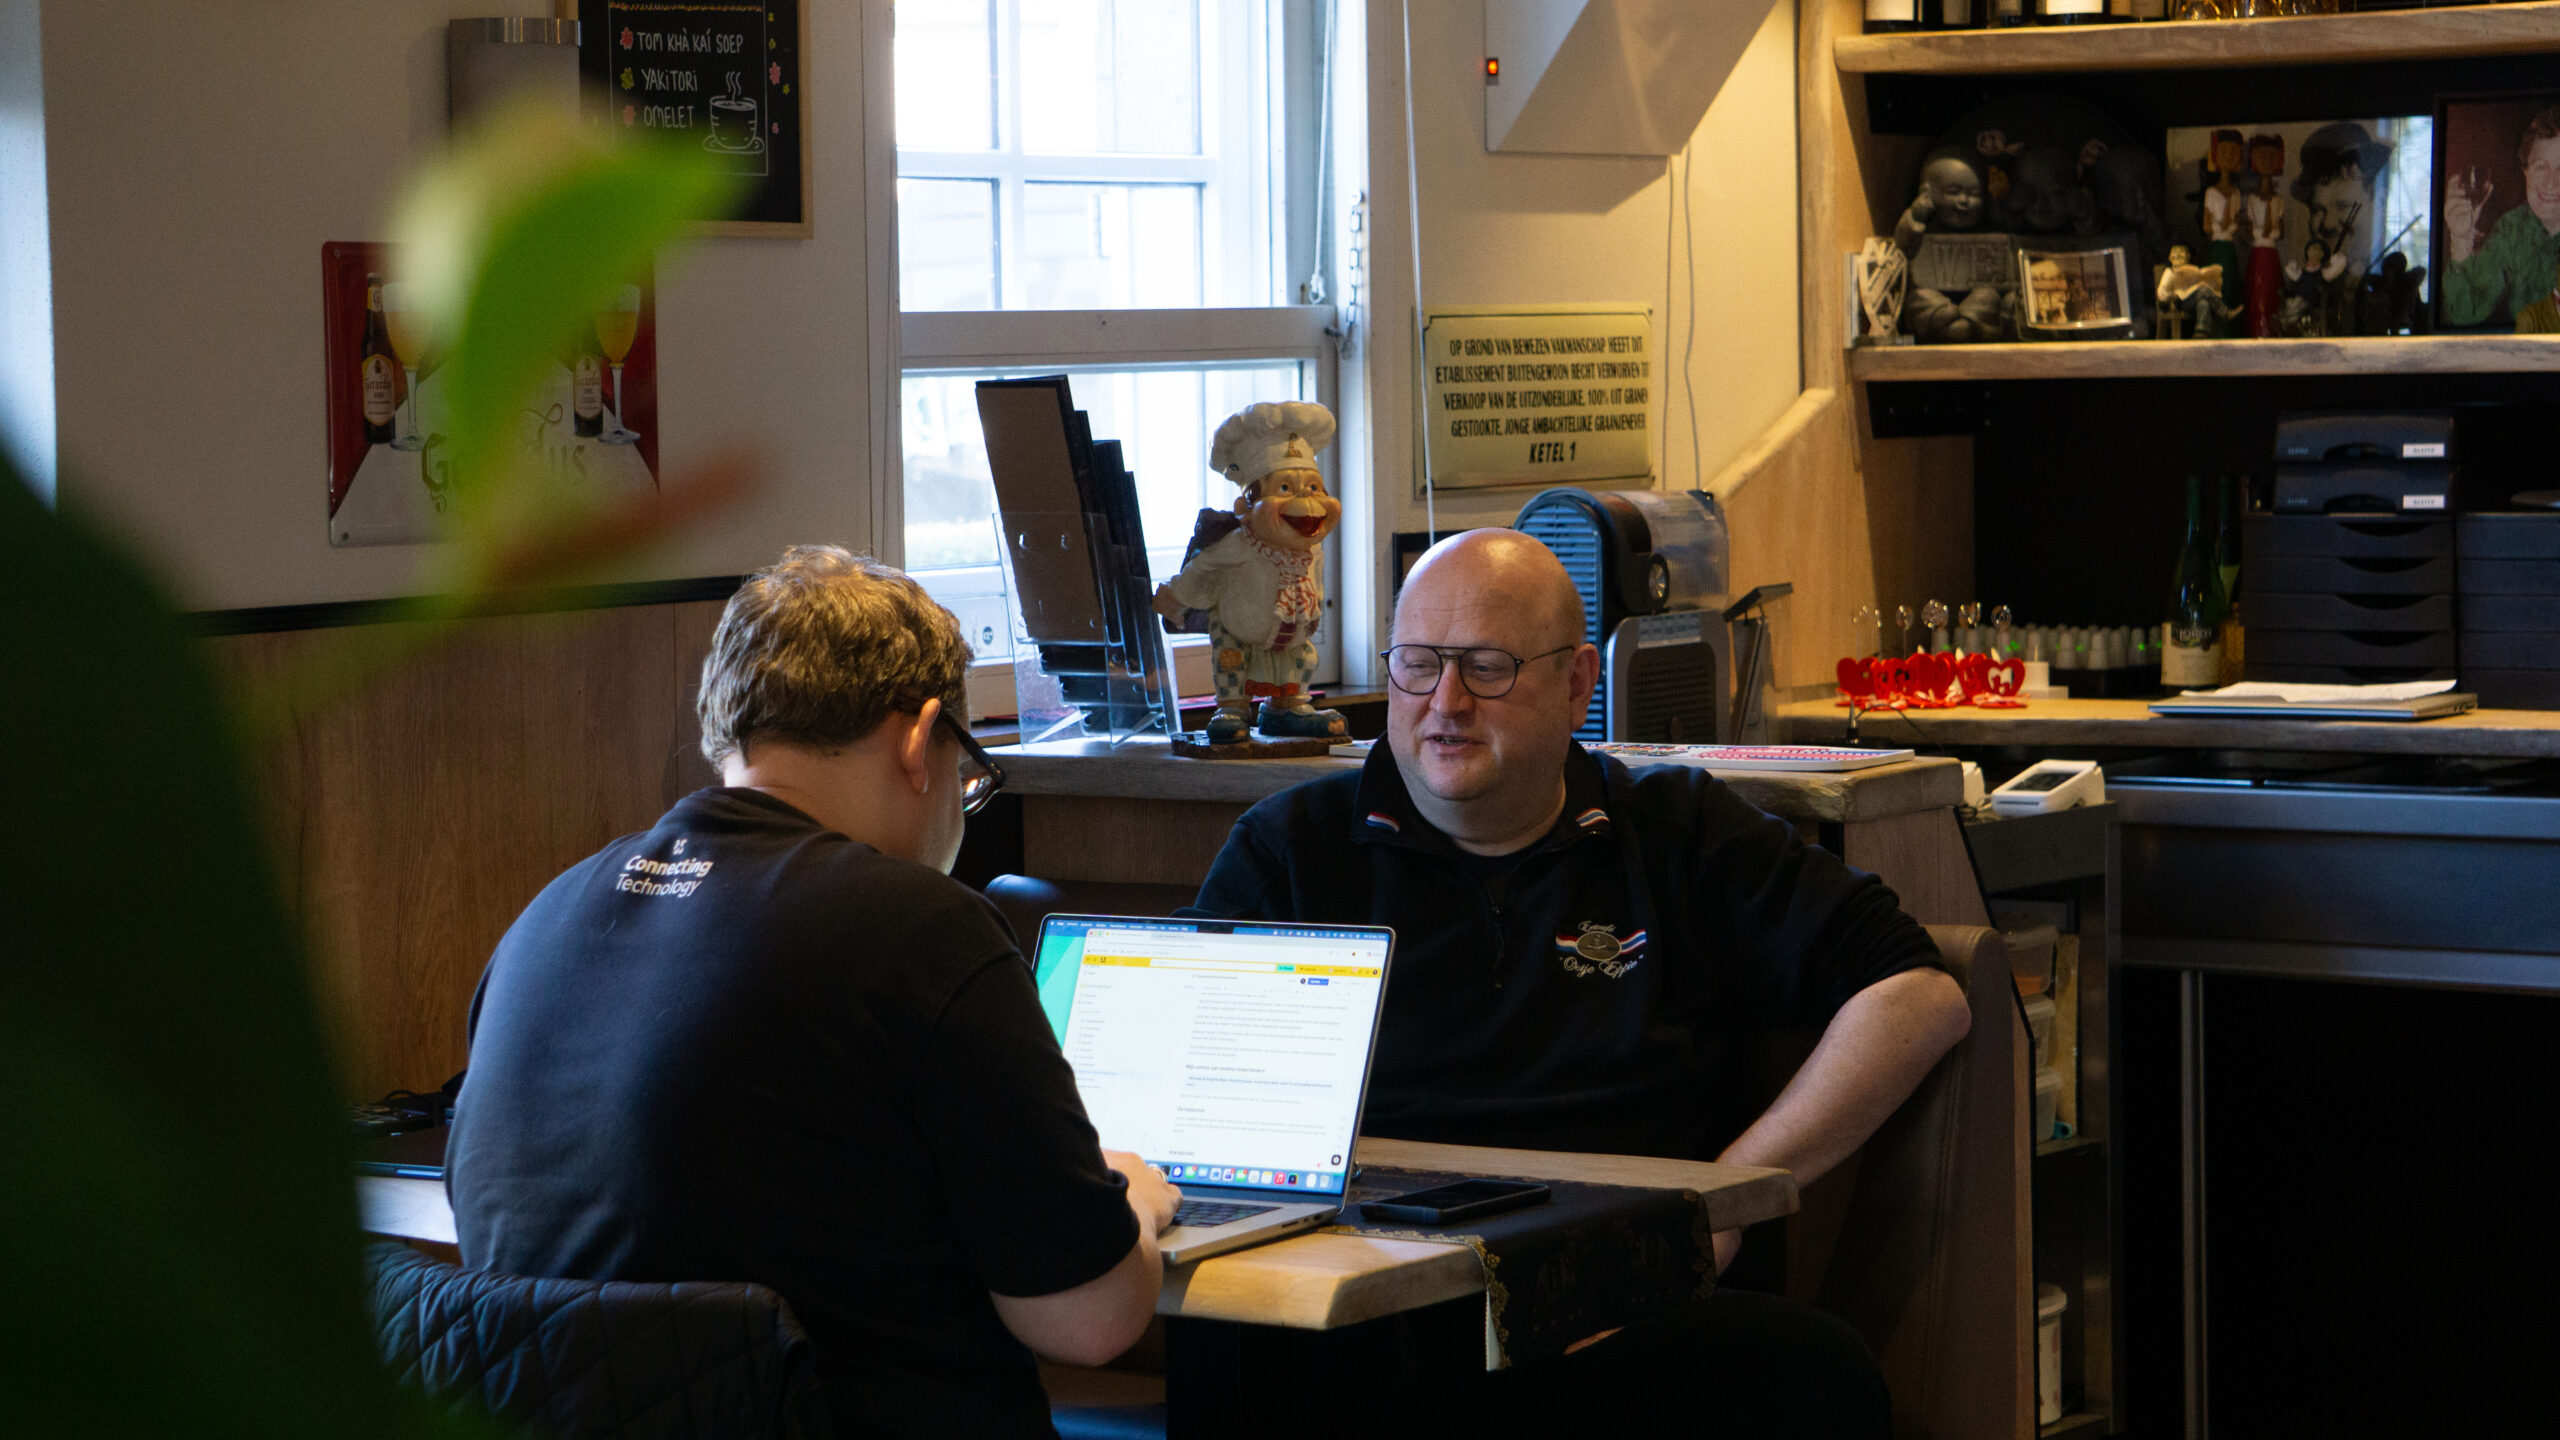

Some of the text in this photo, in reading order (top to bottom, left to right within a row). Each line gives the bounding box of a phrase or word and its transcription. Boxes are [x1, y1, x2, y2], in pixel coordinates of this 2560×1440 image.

[637, 31, 663, 51] TOM
[716, 34, 744, 54] SOEP
[643, 105, 695, 128] OMELET
[1450, 336, 1642, 356] OP GROND VAN BEWEZEN VAKMANSCHAP HEEFT DIT
[1436, 364, 1505, 383] ETABLISSEMENT
[1507, 363, 1569, 382] BUITENGEWOON
[1571, 362, 1595, 380] RECHT
[1597, 362, 1639, 378] VERWORVEN
[1443, 391, 1486, 411] VERKOOP
[1488, 391, 1504, 410] VAN
[1506, 391, 1517, 409] DE
[1588, 389, 1608, 406] 100%
[1610, 388, 1622, 405] UIT
[1504, 417, 1529, 435] JONGE
[1532, 415, 1592, 433] AMBACHTELIJKE
[1529, 442, 1577, 464] KETEL 1
[624, 854, 714, 877] Connecting
[615, 873, 703, 898] Technology
